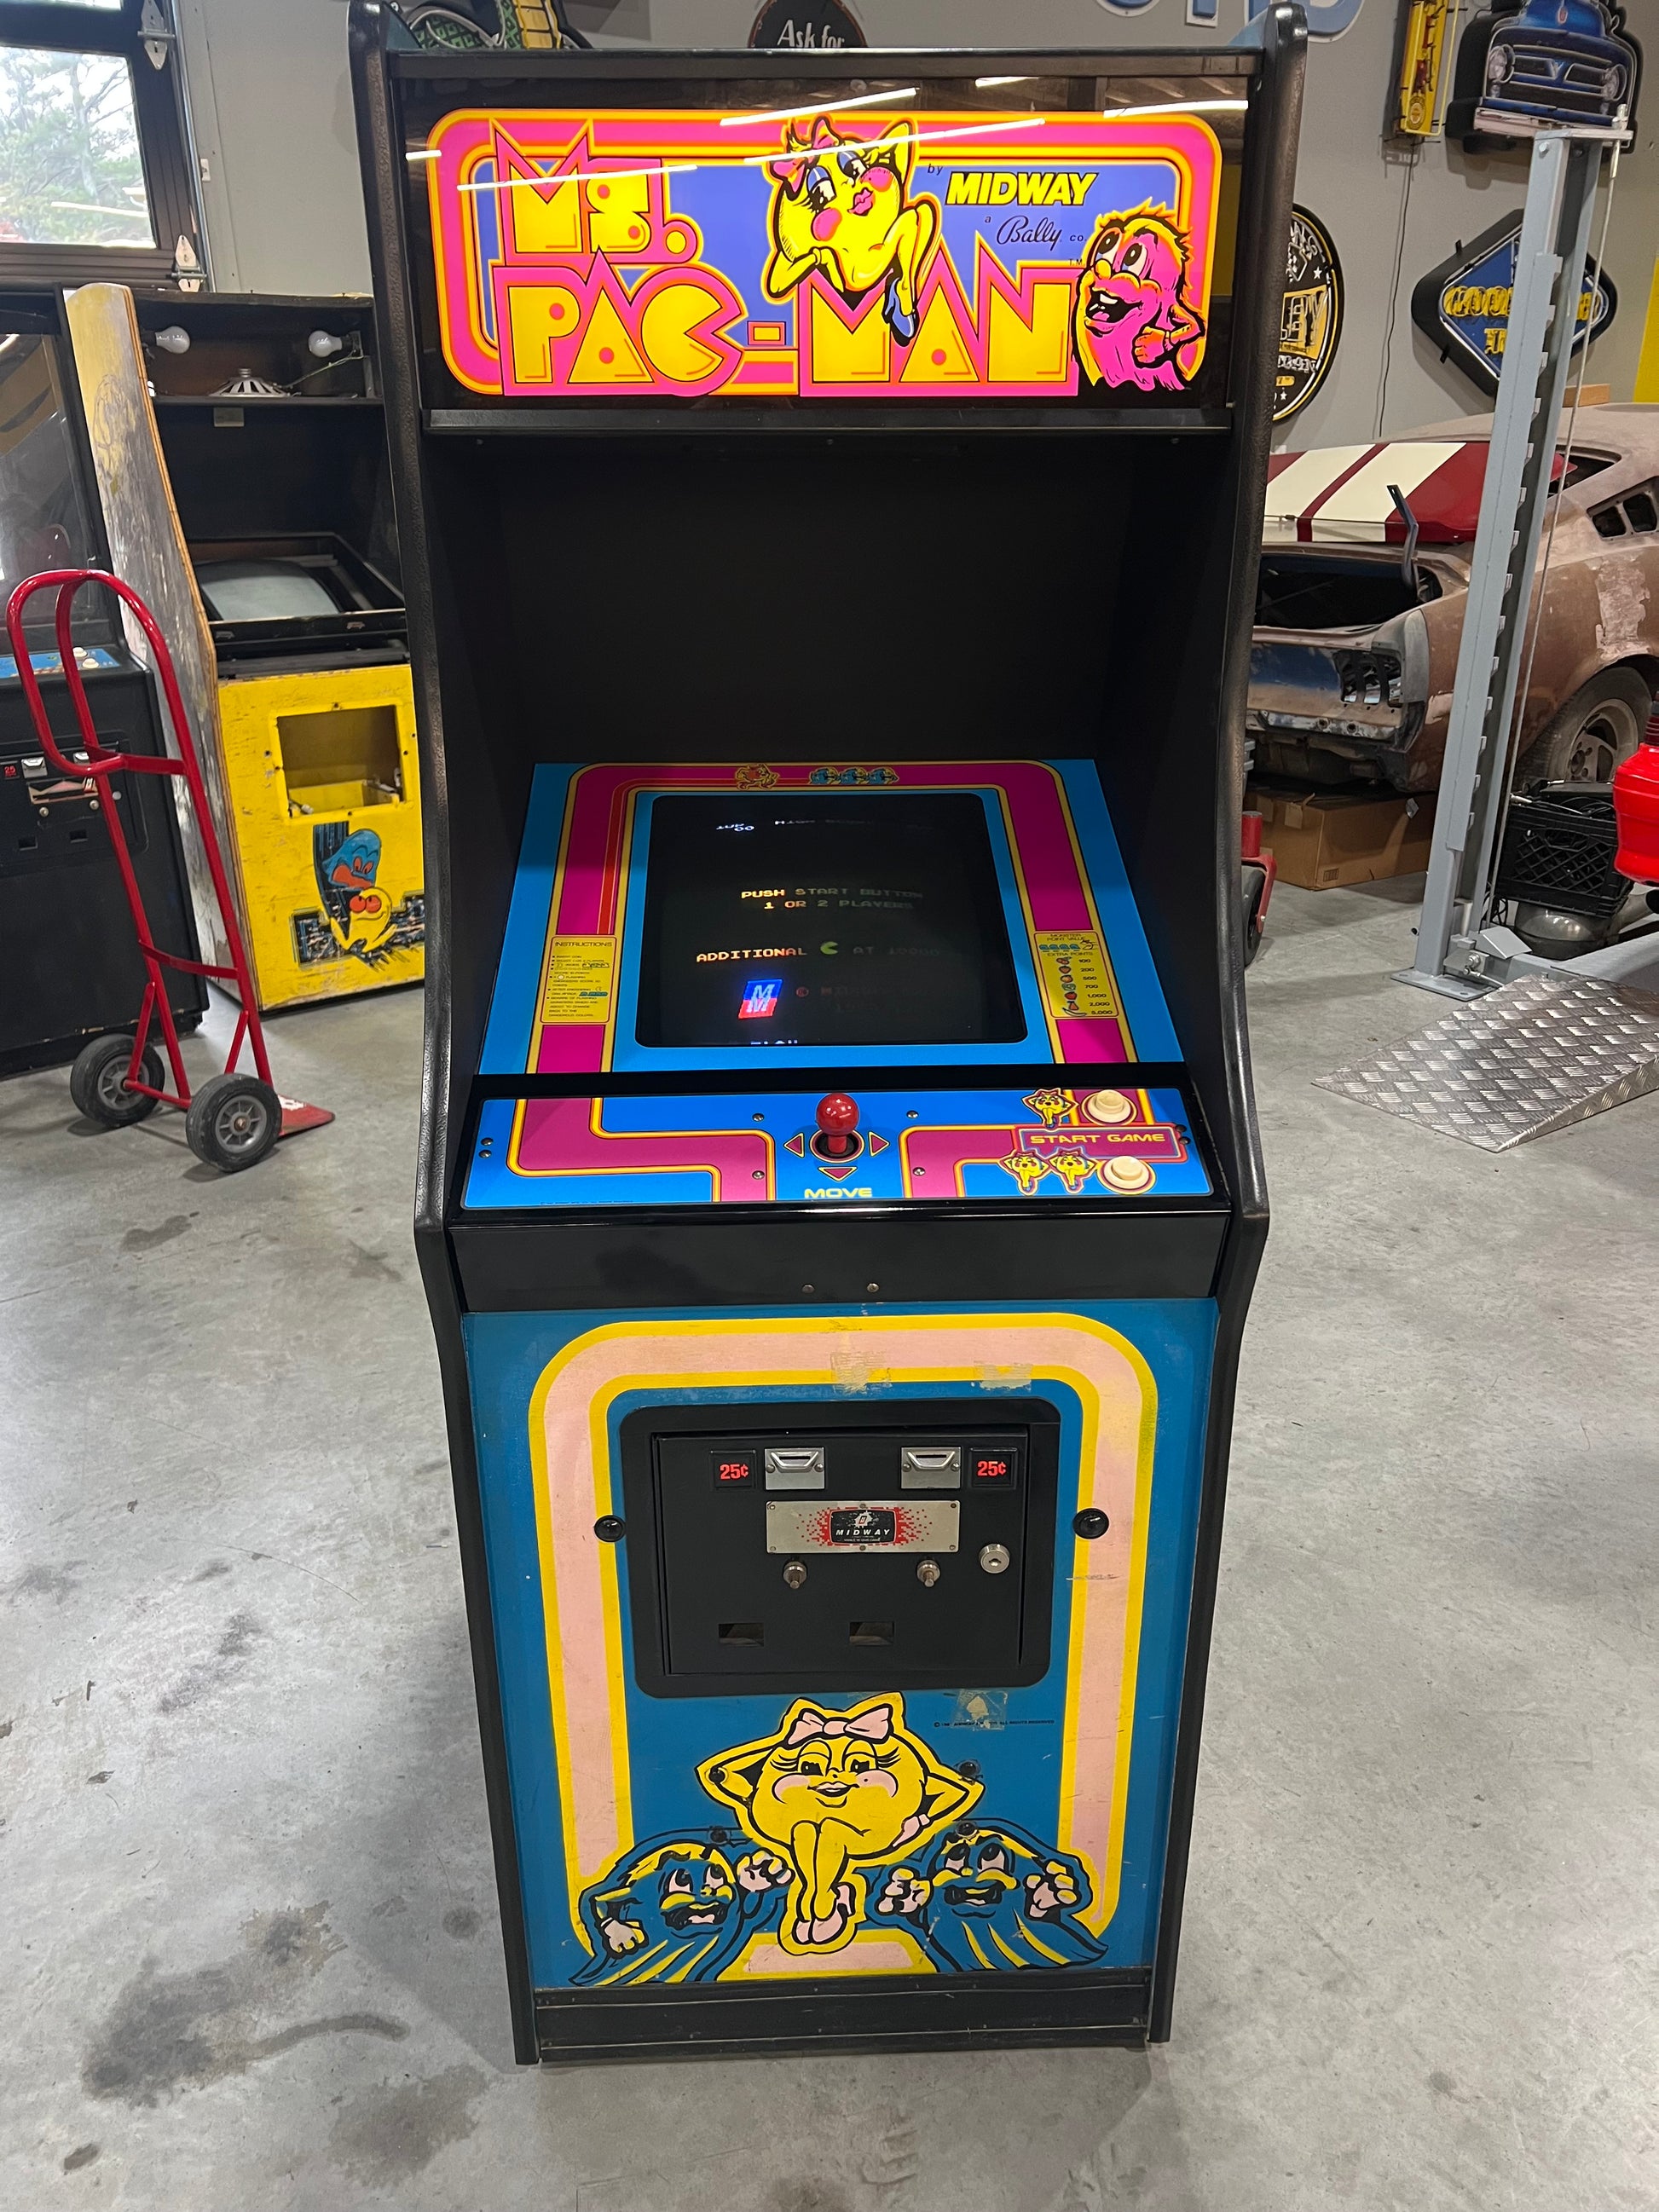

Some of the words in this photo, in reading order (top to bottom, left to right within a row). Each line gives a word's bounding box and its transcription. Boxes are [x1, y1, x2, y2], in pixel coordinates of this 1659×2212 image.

[777, 19, 816, 48] Ask
[821, 24, 846, 48] for
[927, 164, 944, 176] by
[945, 171, 1100, 206] MIDWAY
[984, 215, 991, 223] a
[996, 215, 1063, 251] Bally
[494, 245, 1078, 397] PAC-MAN
[741, 889, 785, 899] PUSH
[795, 887, 848, 897] START
[859, 888, 923, 898] BUTTON
[764, 901, 775, 910] 1
[784, 900, 807, 909] OR
[817, 899, 829, 908] 2
[838, 899, 914, 910] PLAYERS
[696, 947, 807, 963] ADDITIONAL
[853, 946, 875, 956] AT
[1030, 1134, 1101, 1145] START
[1107, 1133, 1166, 1143] GAME
[804, 1187, 872, 1198] MOVE
[719, 1464, 749, 1480] 25¢
[977, 1460, 1006, 1477] 25¢
